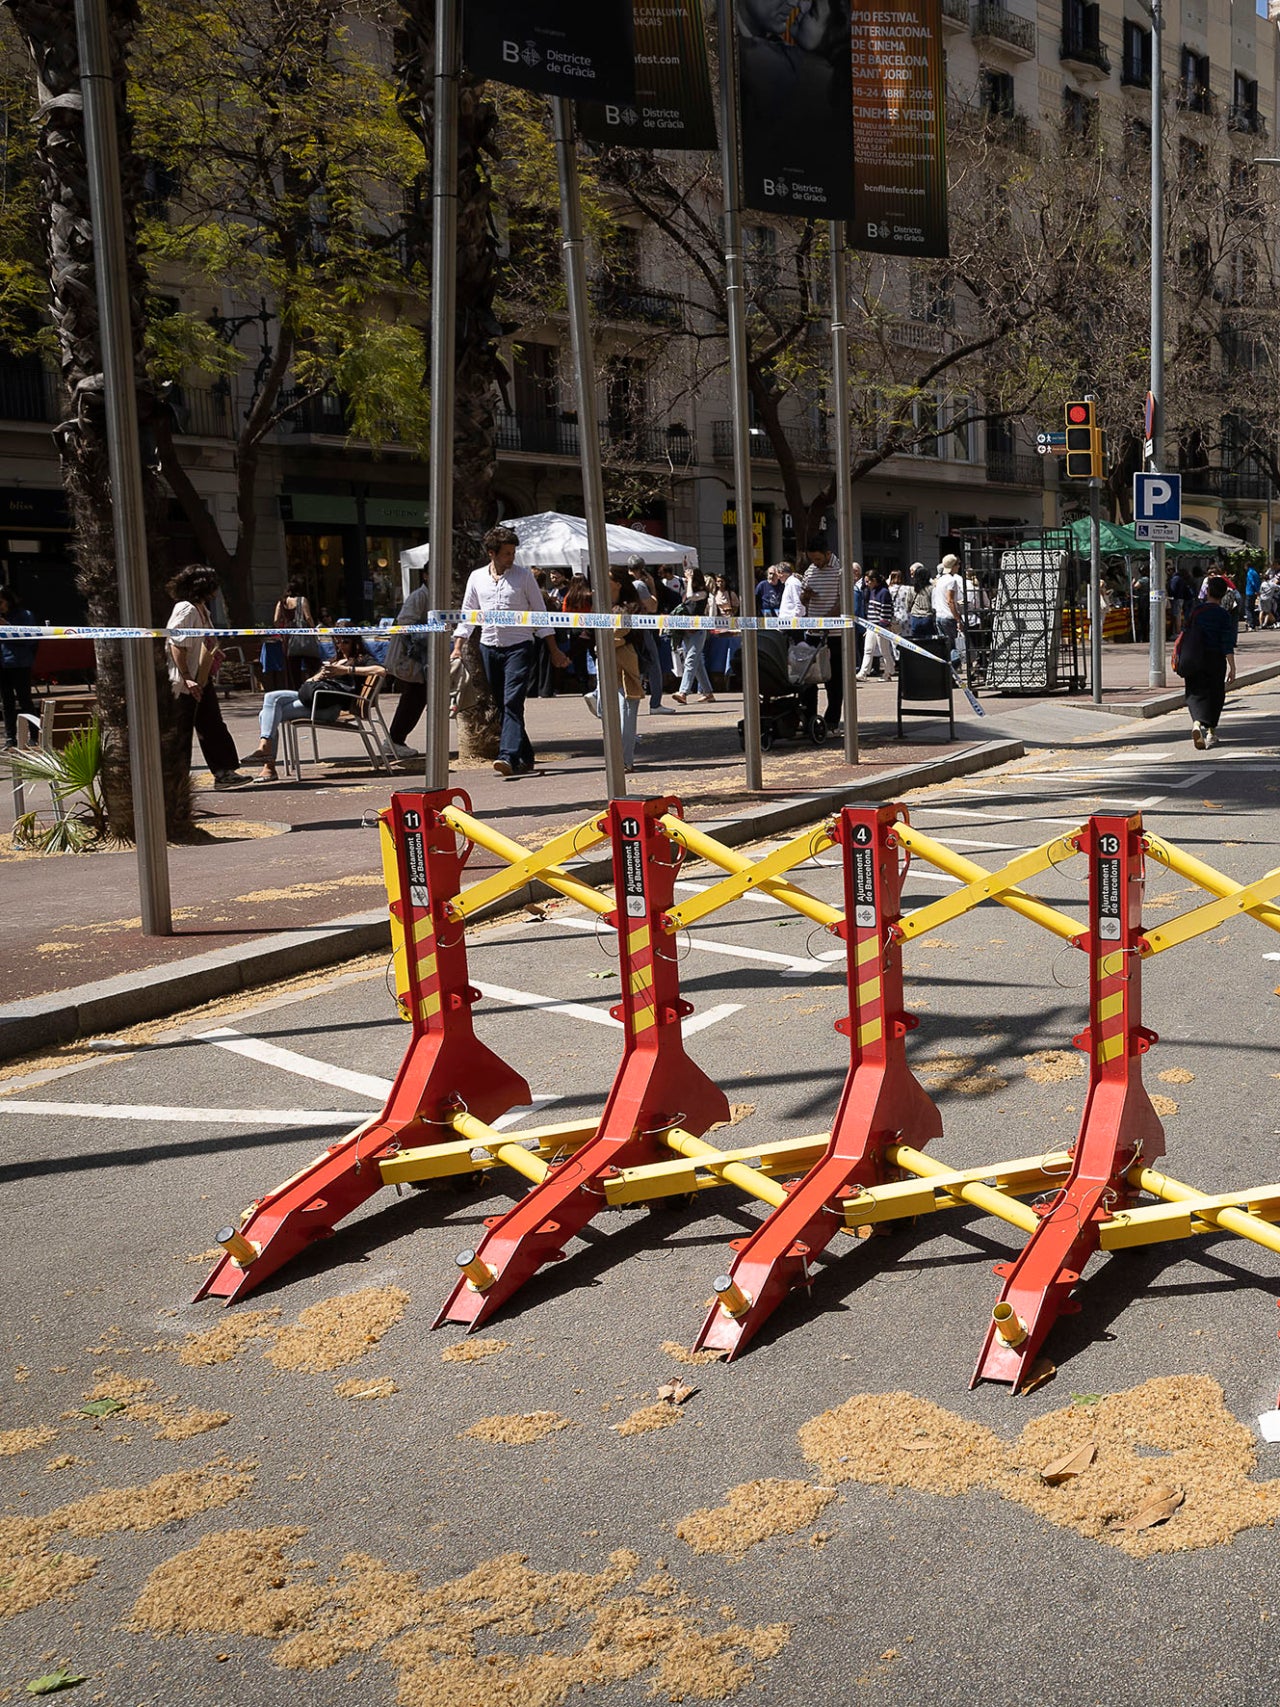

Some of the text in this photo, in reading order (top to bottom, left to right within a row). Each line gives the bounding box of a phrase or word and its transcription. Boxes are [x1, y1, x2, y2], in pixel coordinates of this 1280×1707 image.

[640, 8, 688, 17] CATALUNYA
[851, 11, 919, 23] #10 FESTIVAL
[851, 26, 934, 38] INTERNACIONAL
[502, 39, 520, 63] B
[851, 40, 906, 52] DE CINEMA
[546, 49, 592, 66] Districte
[851, 53, 929, 67] DE BARCELONA
[546, 62, 597, 79] de Gràcia
[852, 67, 913, 80] SANT JORDI
[852, 87, 934, 100] 16-24 ABRIL 2026
[605, 103, 621, 125] B
[642, 107, 680, 119] Districte
[852, 106, 936, 121] CINEMES VERDI
[642, 118, 655, 129] de
[763, 178, 775, 196] B
[792, 182, 824, 194] Districte
[864, 183, 926, 196] bcnfilmfest.com
[867, 222, 878, 238] B
[893, 225, 922, 235] Districte
[1144, 479, 1171, 516] P
[404, 812, 420, 828] 11
[622, 820, 638, 835] 11
[857, 827, 867, 842] 4
[1100, 837, 1119, 853] 13
[408, 837, 418, 883] Ajuntament
[415, 833, 426, 883] de Barcelona
[625, 845, 636, 893] Ajuntament
[633, 841, 643, 893] de Barcelona
[856, 853, 866, 902] Ajuntament
[864, 849, 873, 902] de Barcelona
[1101, 864, 1111, 914] Ajuntament
[1110, 859, 1119, 914] de Barcelona
